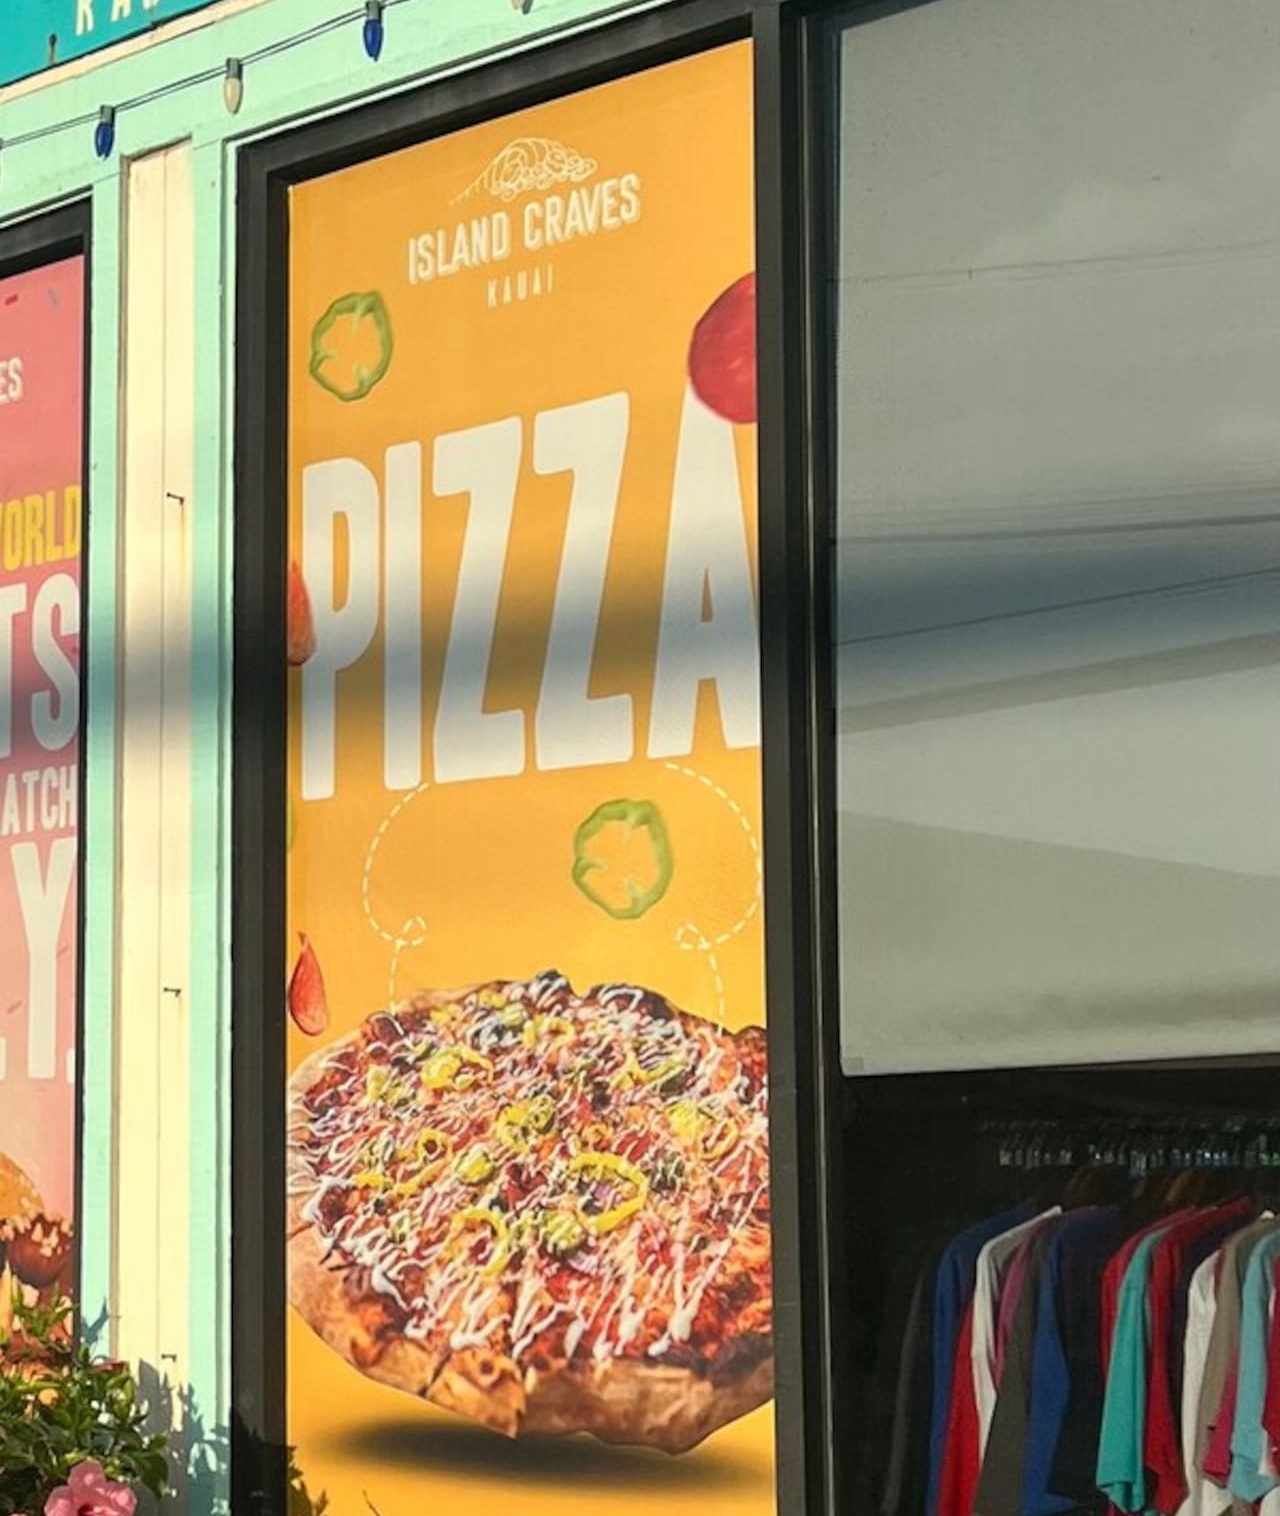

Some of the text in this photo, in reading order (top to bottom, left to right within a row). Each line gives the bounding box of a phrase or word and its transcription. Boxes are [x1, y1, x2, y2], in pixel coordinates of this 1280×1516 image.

[408, 173, 640, 285] ISLAND CRAVES
[487, 263, 553, 308] KAUAI
[301, 376, 760, 801] PIZZA
